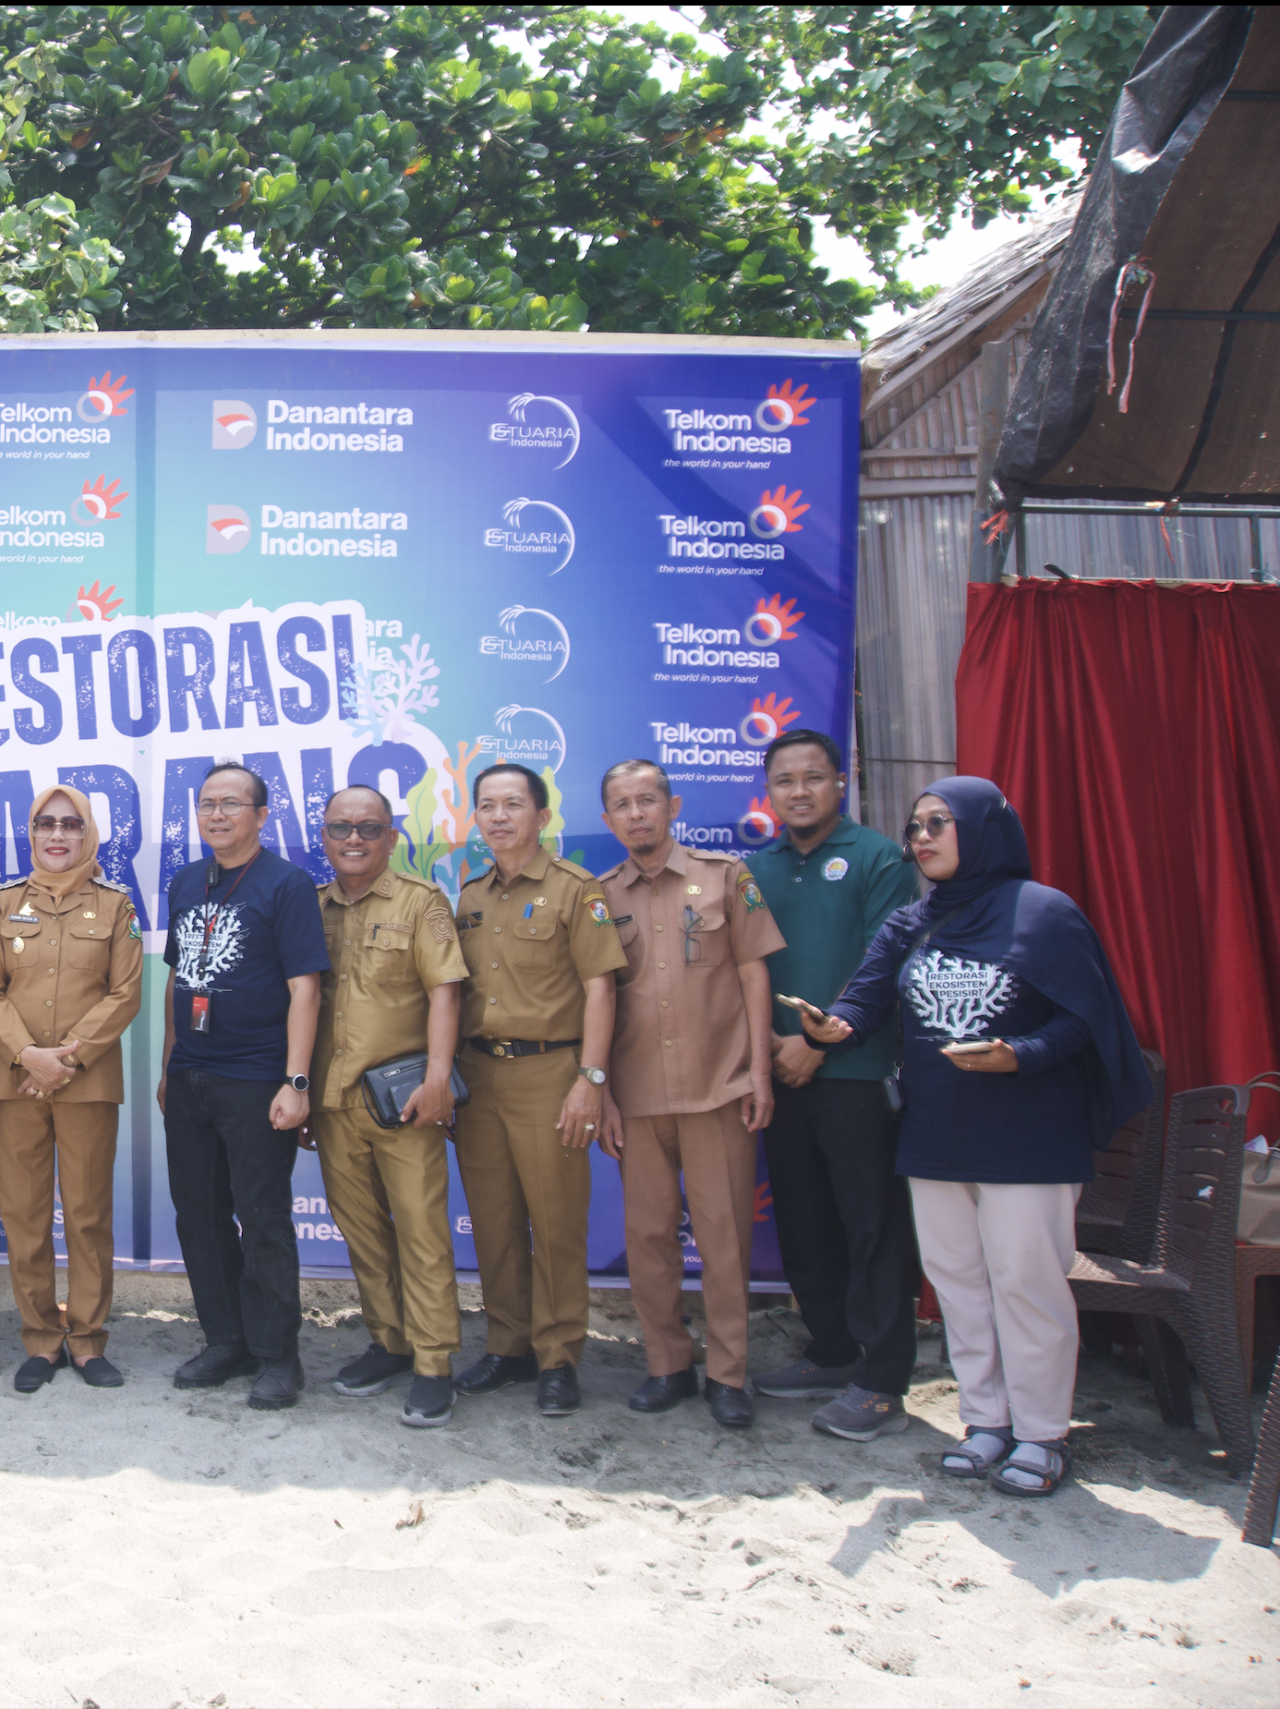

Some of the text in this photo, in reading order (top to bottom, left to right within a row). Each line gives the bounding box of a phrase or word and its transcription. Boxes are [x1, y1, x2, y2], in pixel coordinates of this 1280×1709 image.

[266, 400, 414, 425] Danantara
[664, 409, 752, 431] Telkom
[0, 423, 111, 444] Indonesia
[266, 426, 405, 452] Indonesia
[490, 423, 576, 441] ESTUARIA
[510, 438, 563, 447] Indonesia
[675, 430, 792, 454] Indonesia
[5, 450, 33, 459] world
[33, 451, 42, 460] in
[43, 452, 65, 462] your
[66, 451, 91, 460] hand
[664, 459, 771, 470] the world in your hand
[261, 505, 408, 530] Danantara
[658, 514, 746, 537] Telkom
[260, 531, 398, 557] Indonesia
[484, 528, 571, 547] ESTUARIA
[505, 543, 557, 553] Indonesia
[669, 536, 785, 560] Indonesia
[0, 554, 26, 563] world
[27, 554, 36, 563] in
[37, 556, 59, 564] your
[60, 555, 84, 564] hand
[658, 565, 765, 576] the world in your hand
[654, 623, 741, 645] Telkom
[480, 636, 566, 654] ESTUARIA
[500, 651, 552, 661] Indonesia
[665, 644, 780, 668] Indonesia
[654, 673, 759, 684] the world in your hand
[651, 722, 737, 744] Telkom
[496, 750, 548, 760] Indonesia
[668, 773, 755, 783] world in your hand
[930, 971, 988, 981] RESTORASI
[929, 981, 988, 990] EKOSISTEM
[940, 989, 979, 998] PESISIR
